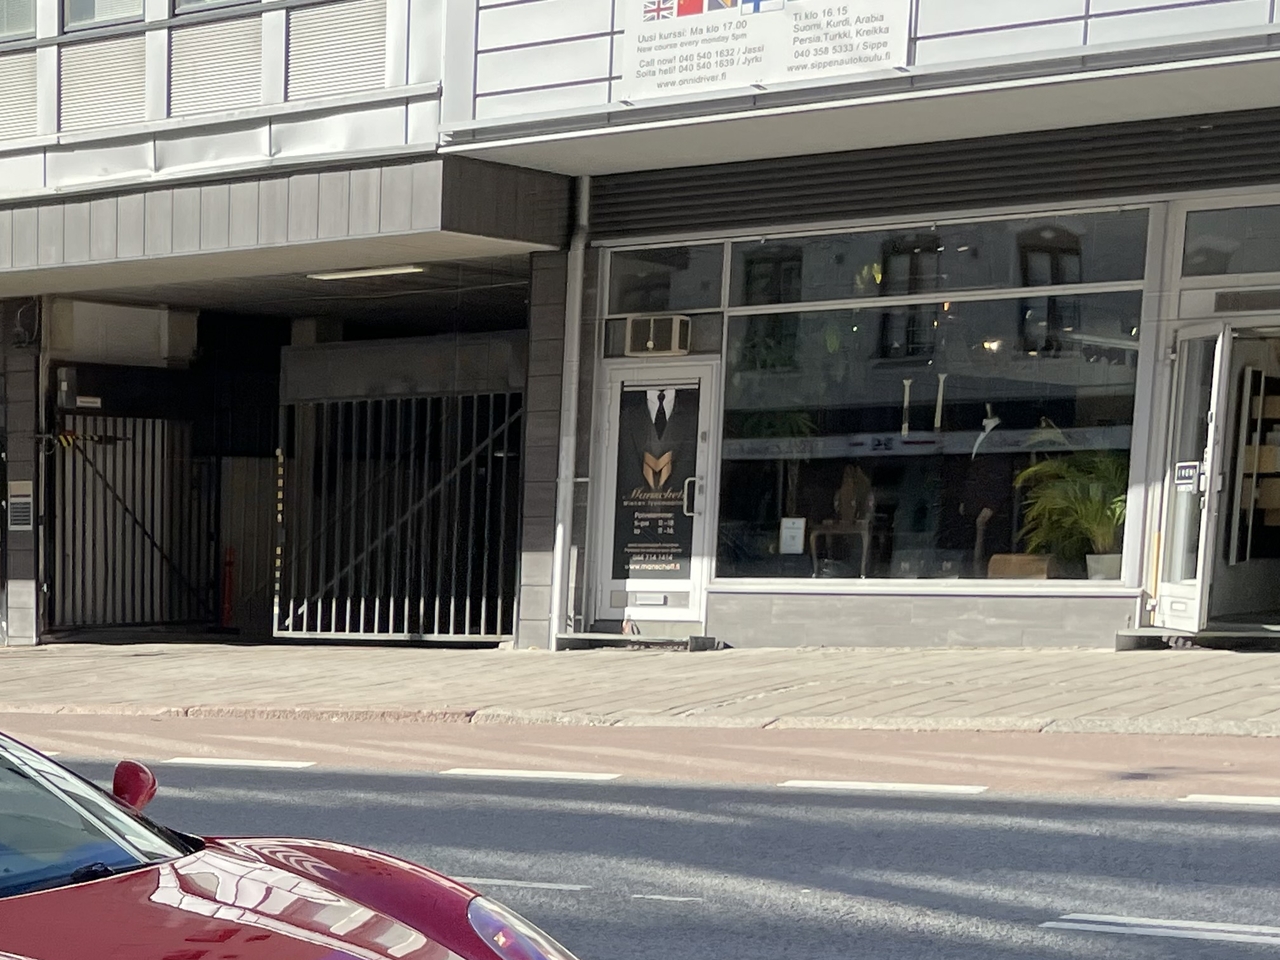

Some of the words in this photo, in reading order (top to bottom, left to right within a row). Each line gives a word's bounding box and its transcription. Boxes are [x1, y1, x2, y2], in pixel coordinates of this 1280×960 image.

[793, 12, 802, 22] Ti
[804, 10, 818, 20] klo
[822, 6, 848, 18] 16.15
[638, 33, 657, 44] Uusi
[659, 30, 687, 40] kurssi:
[690, 26, 704, 36] Ma
[706, 23, 719, 33] klo
[722, 20, 747, 31] 17.00
[793, 22, 823, 33] Suomi,
[826, 18, 852, 29] Kurdi,
[855, 14, 885, 25] Arabia
[855, 26, 890, 38] Kreikka
[654, 43, 678, 51] course
[680, 39, 699, 48] every
[701, 34, 729, 45] monday
[731, 33, 747, 42] 5pm
[793, 49, 810, 59] 040
[812, 46, 829, 56] 358
[832, 43, 854, 54] 5333
[862, 40, 888, 51] Sippe
[635, 69, 656, 79] Soita
[658, 66, 676, 76] heti!
[678, 63, 695, 73] 040
[696, 61, 712, 71] 540
[742, 55, 763, 67] Jyrki
[639, 58, 655, 69] Call
[657, 56, 676, 66] now!
[678, 54, 695, 64] 040
[696, 51, 712, 61] 540
[787, 52, 891, 72] www.sippenautokoulu.fi
[657, 72, 727, 88] www.onnidriver.fi
